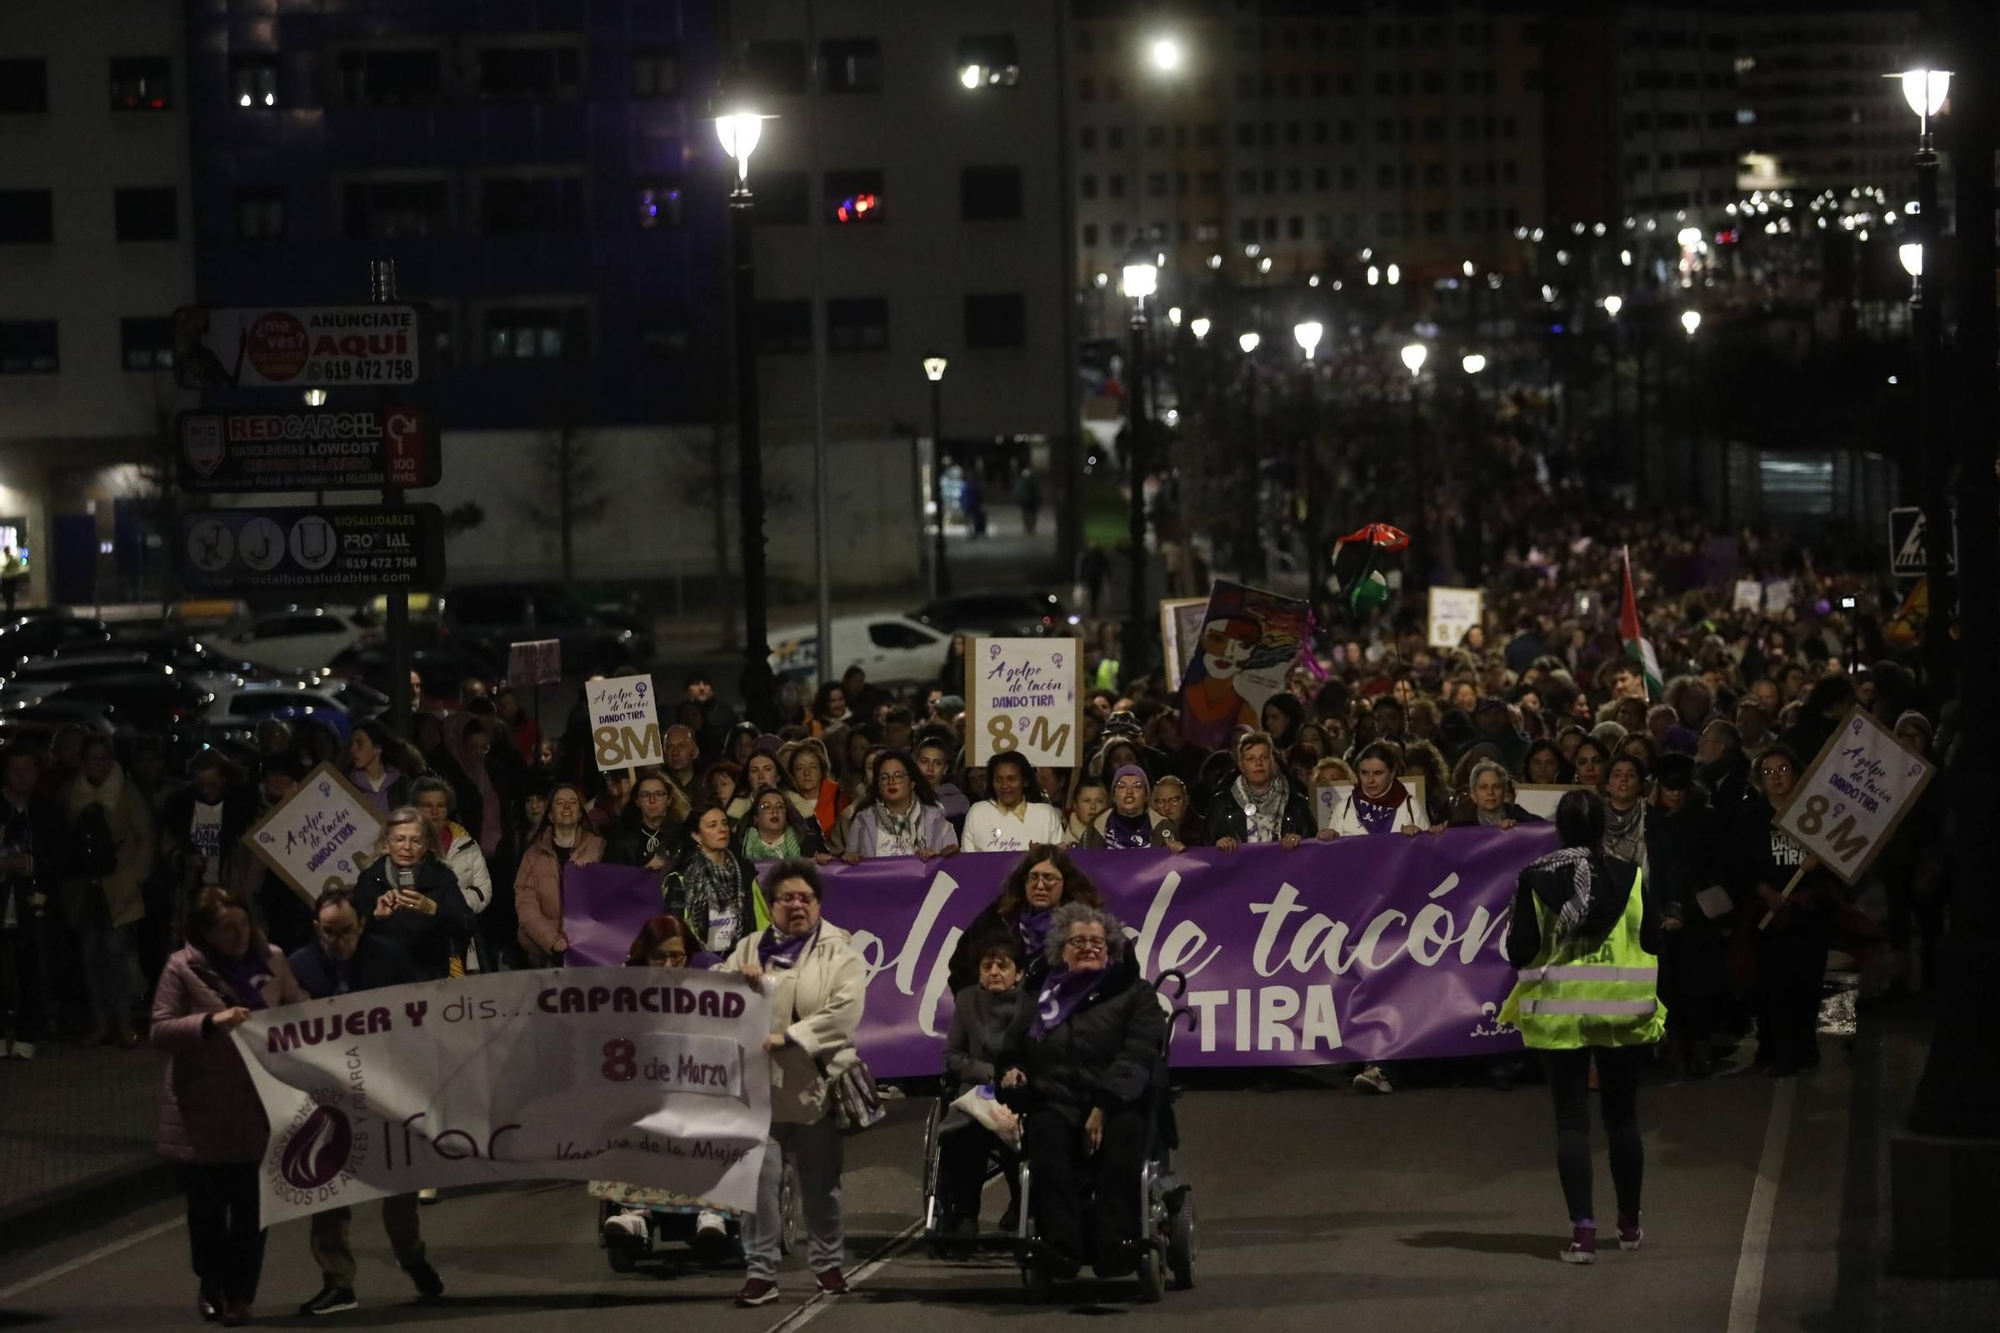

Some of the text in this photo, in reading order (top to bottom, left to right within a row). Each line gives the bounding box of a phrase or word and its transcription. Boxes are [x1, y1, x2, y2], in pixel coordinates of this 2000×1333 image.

[255, 320, 290, 338] ¿me
[310, 311, 411, 328] ANÚNCIATE
[266, 332, 305, 350] ves?
[312, 329, 408, 358] AQUÍ
[325, 360, 413, 380] 619 472 758
[308, 442, 379, 456] LOWCOST
[393, 459, 415, 470] 100
[334, 515, 416, 526] BIOSALUDABLES
[343, 532, 411, 548] PROIAL
[345, 557, 417, 570] 619 472 758
[988, 660, 1042, 682] A golpe
[594, 688, 634, 705] A golpe
[1008, 678, 1061, 693] de tacón
[992, 694, 1055, 708] DANDO TIRA
[599, 711, 645, 724] DANDO TIRA
[594, 723, 661, 766] 8M
[1842, 747, 1886, 778] A golpe
[1829, 773, 1880, 813] DANDO TIRA
[1850, 769, 1893, 803] de tacón
[285, 812, 323, 855] A golpe
[310, 809, 350, 849] de tacón
[307, 842, 337, 872] DANDO
[332, 823, 357, 845] TIRA
[1120, 870, 1224, 981] de
[268, 1007, 392, 1053] MUJER
[405, 1000, 428, 1027] Y
[537, 987, 746, 1018] CAPACIDAD
[1188, 984, 1343, 1052] TIRA
[601, 1038, 727, 1087] 8 de Marzo
[319, 1182, 339, 1202] DE
[354, 1115, 369, 1126] Y
[640, 1135, 660, 1152] de
[667, 1139, 685, 1156] la
[692, 1140, 750, 1167] Mujer
